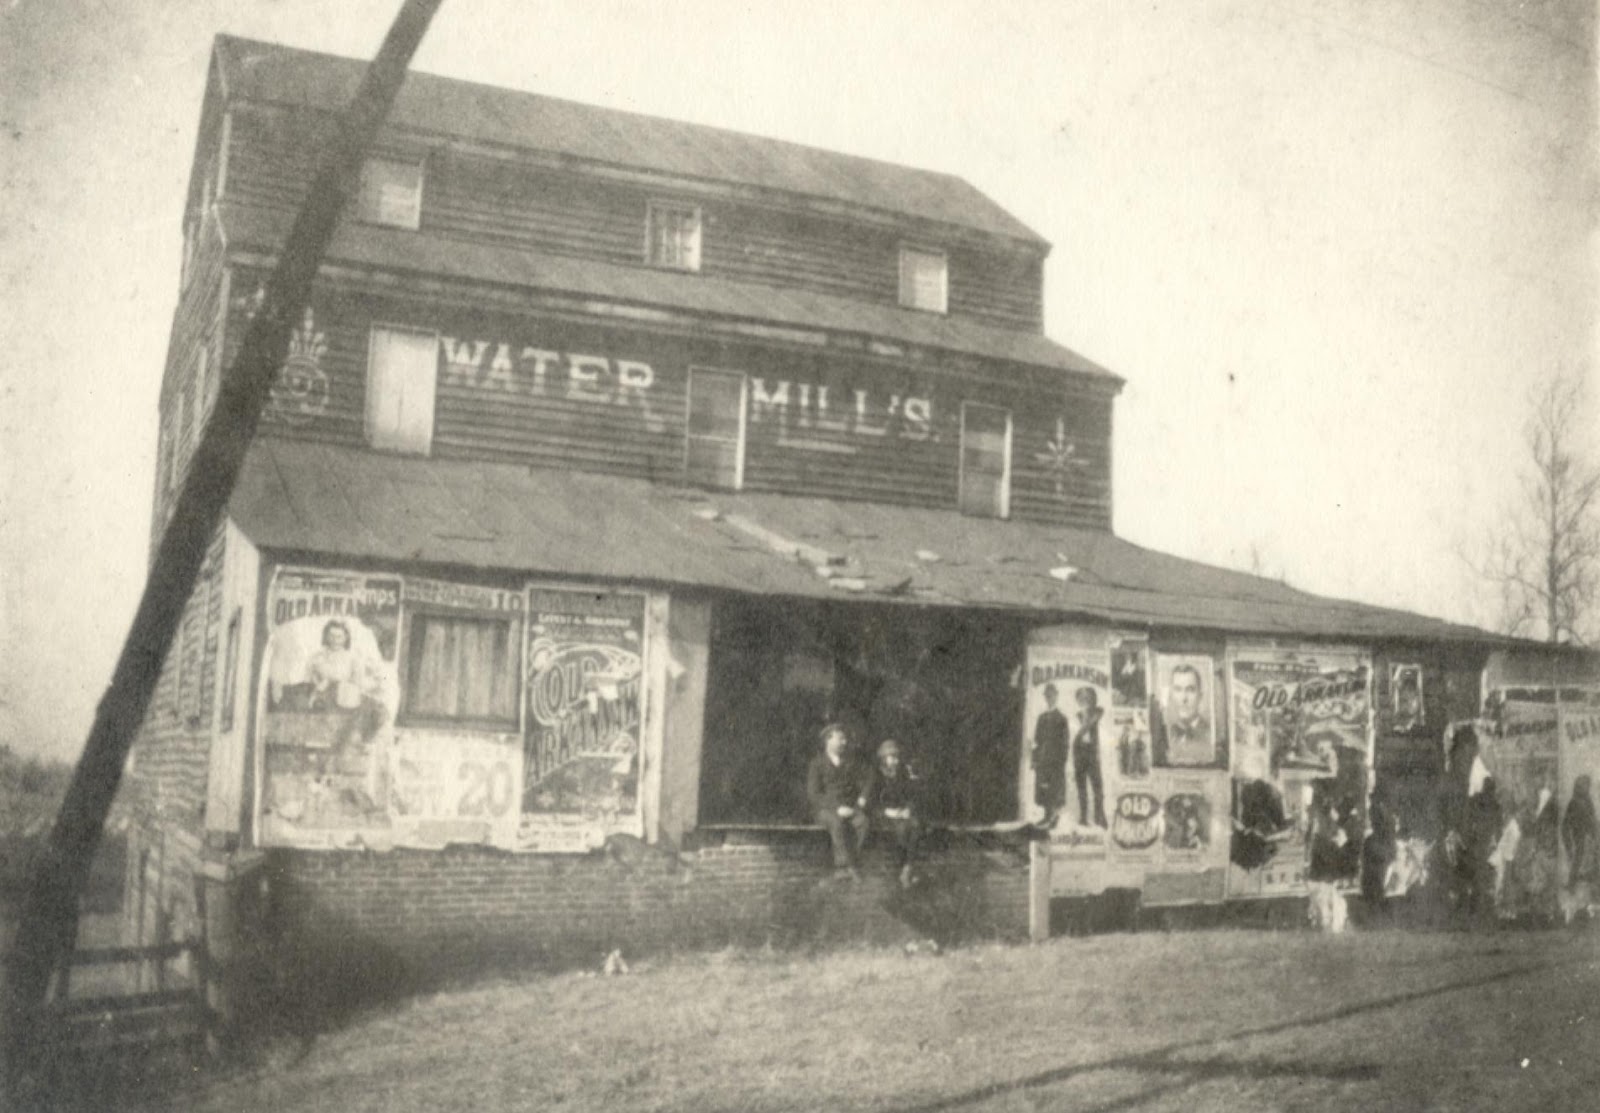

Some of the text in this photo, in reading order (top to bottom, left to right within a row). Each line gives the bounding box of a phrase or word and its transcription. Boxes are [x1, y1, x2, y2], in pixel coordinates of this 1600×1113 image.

[440, 335, 657, 408] WATER
[1252, 685, 1288, 710] OLD
[1120, 796, 1152, 818] OLD
